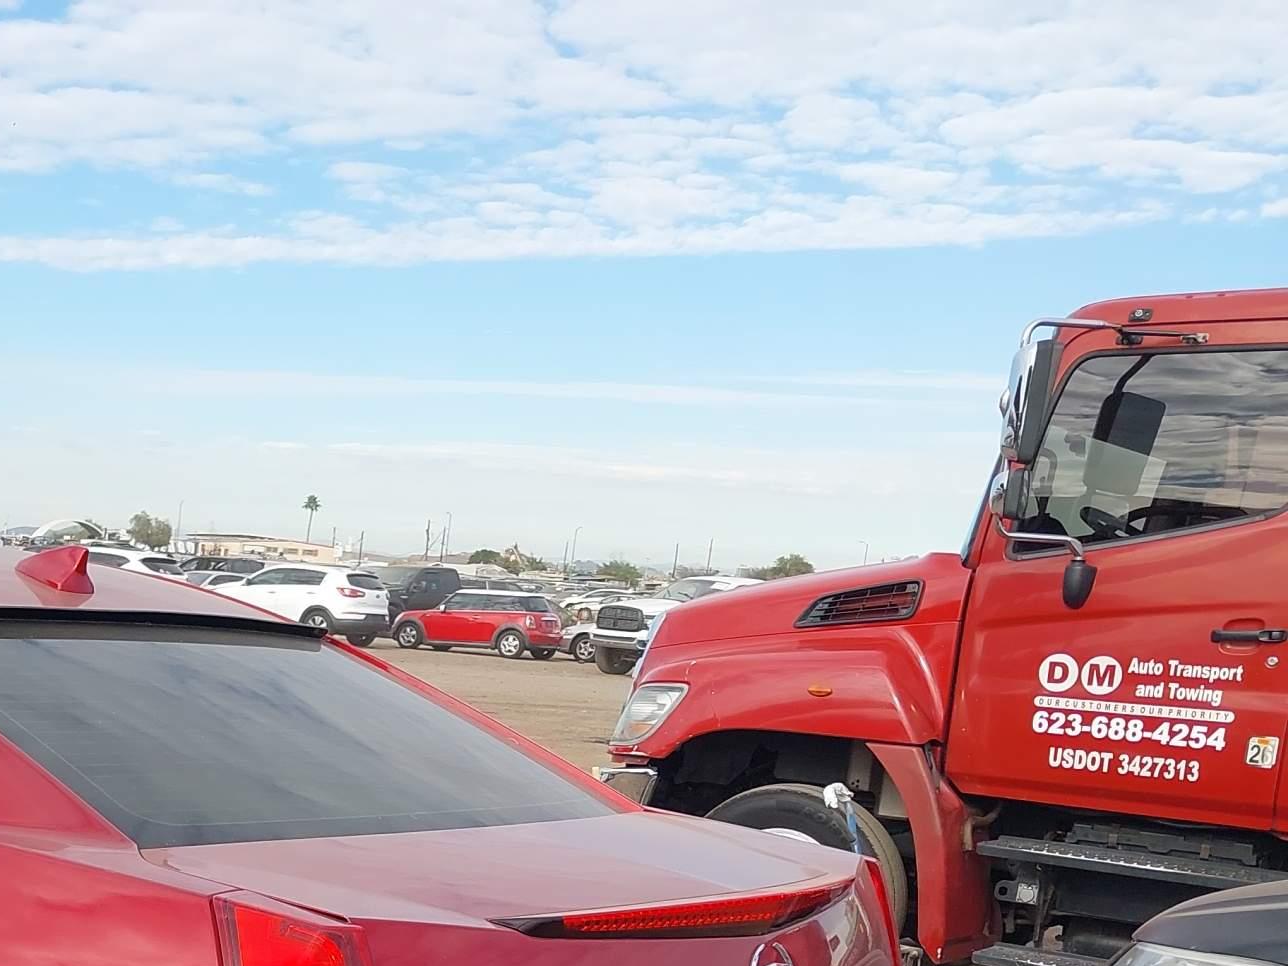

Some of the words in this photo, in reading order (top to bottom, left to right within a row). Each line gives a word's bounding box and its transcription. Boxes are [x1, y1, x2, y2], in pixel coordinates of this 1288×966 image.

[1047, 661, 1070, 684] D
[1087, 663, 1117, 688] M
[1128, 657, 1163, 677] Auto
[1168, 659, 1244, 683] Transport
[1135, 682, 1164, 699] and
[1168, 682, 1223, 707] Towing
[1038, 697, 1060, 707] OUR
[1064, 698, 1135, 713] CUSTOMERS
[1139, 706, 1163, 716] OUR
[1167, 708, 1230, 721] PRIORITY
[1032, 710, 1226, 751] 623-688-4254
[1048, 746, 1114, 773] USDOT
[1117, 754, 1200, 782] 3427313
